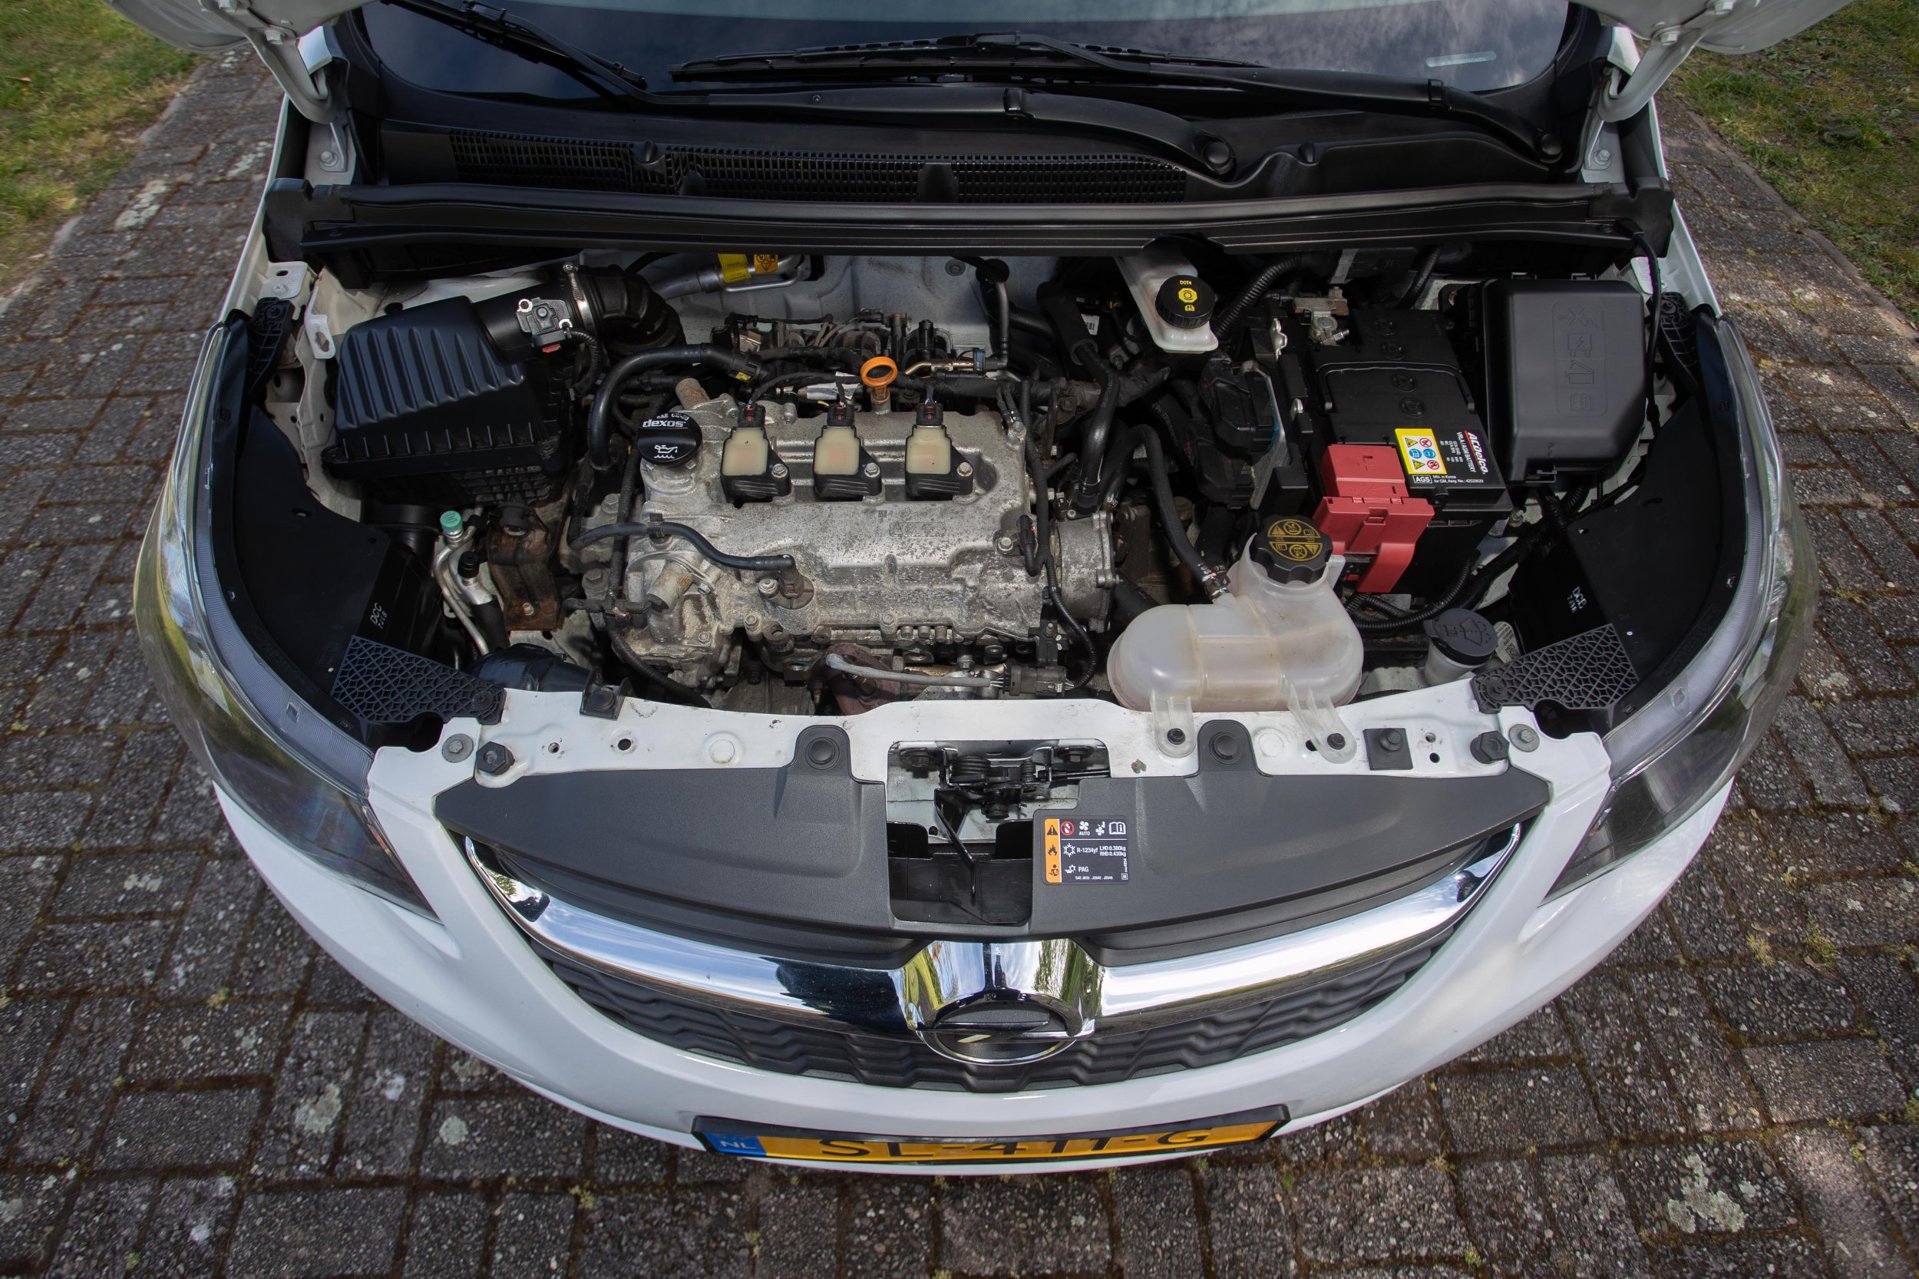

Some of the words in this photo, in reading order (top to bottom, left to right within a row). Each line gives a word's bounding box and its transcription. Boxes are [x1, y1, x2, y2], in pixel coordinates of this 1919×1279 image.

[642, 419, 684, 428] dexos
[1467, 431, 1488, 474] ACDelco
[719, 1140, 757, 1150] NL
